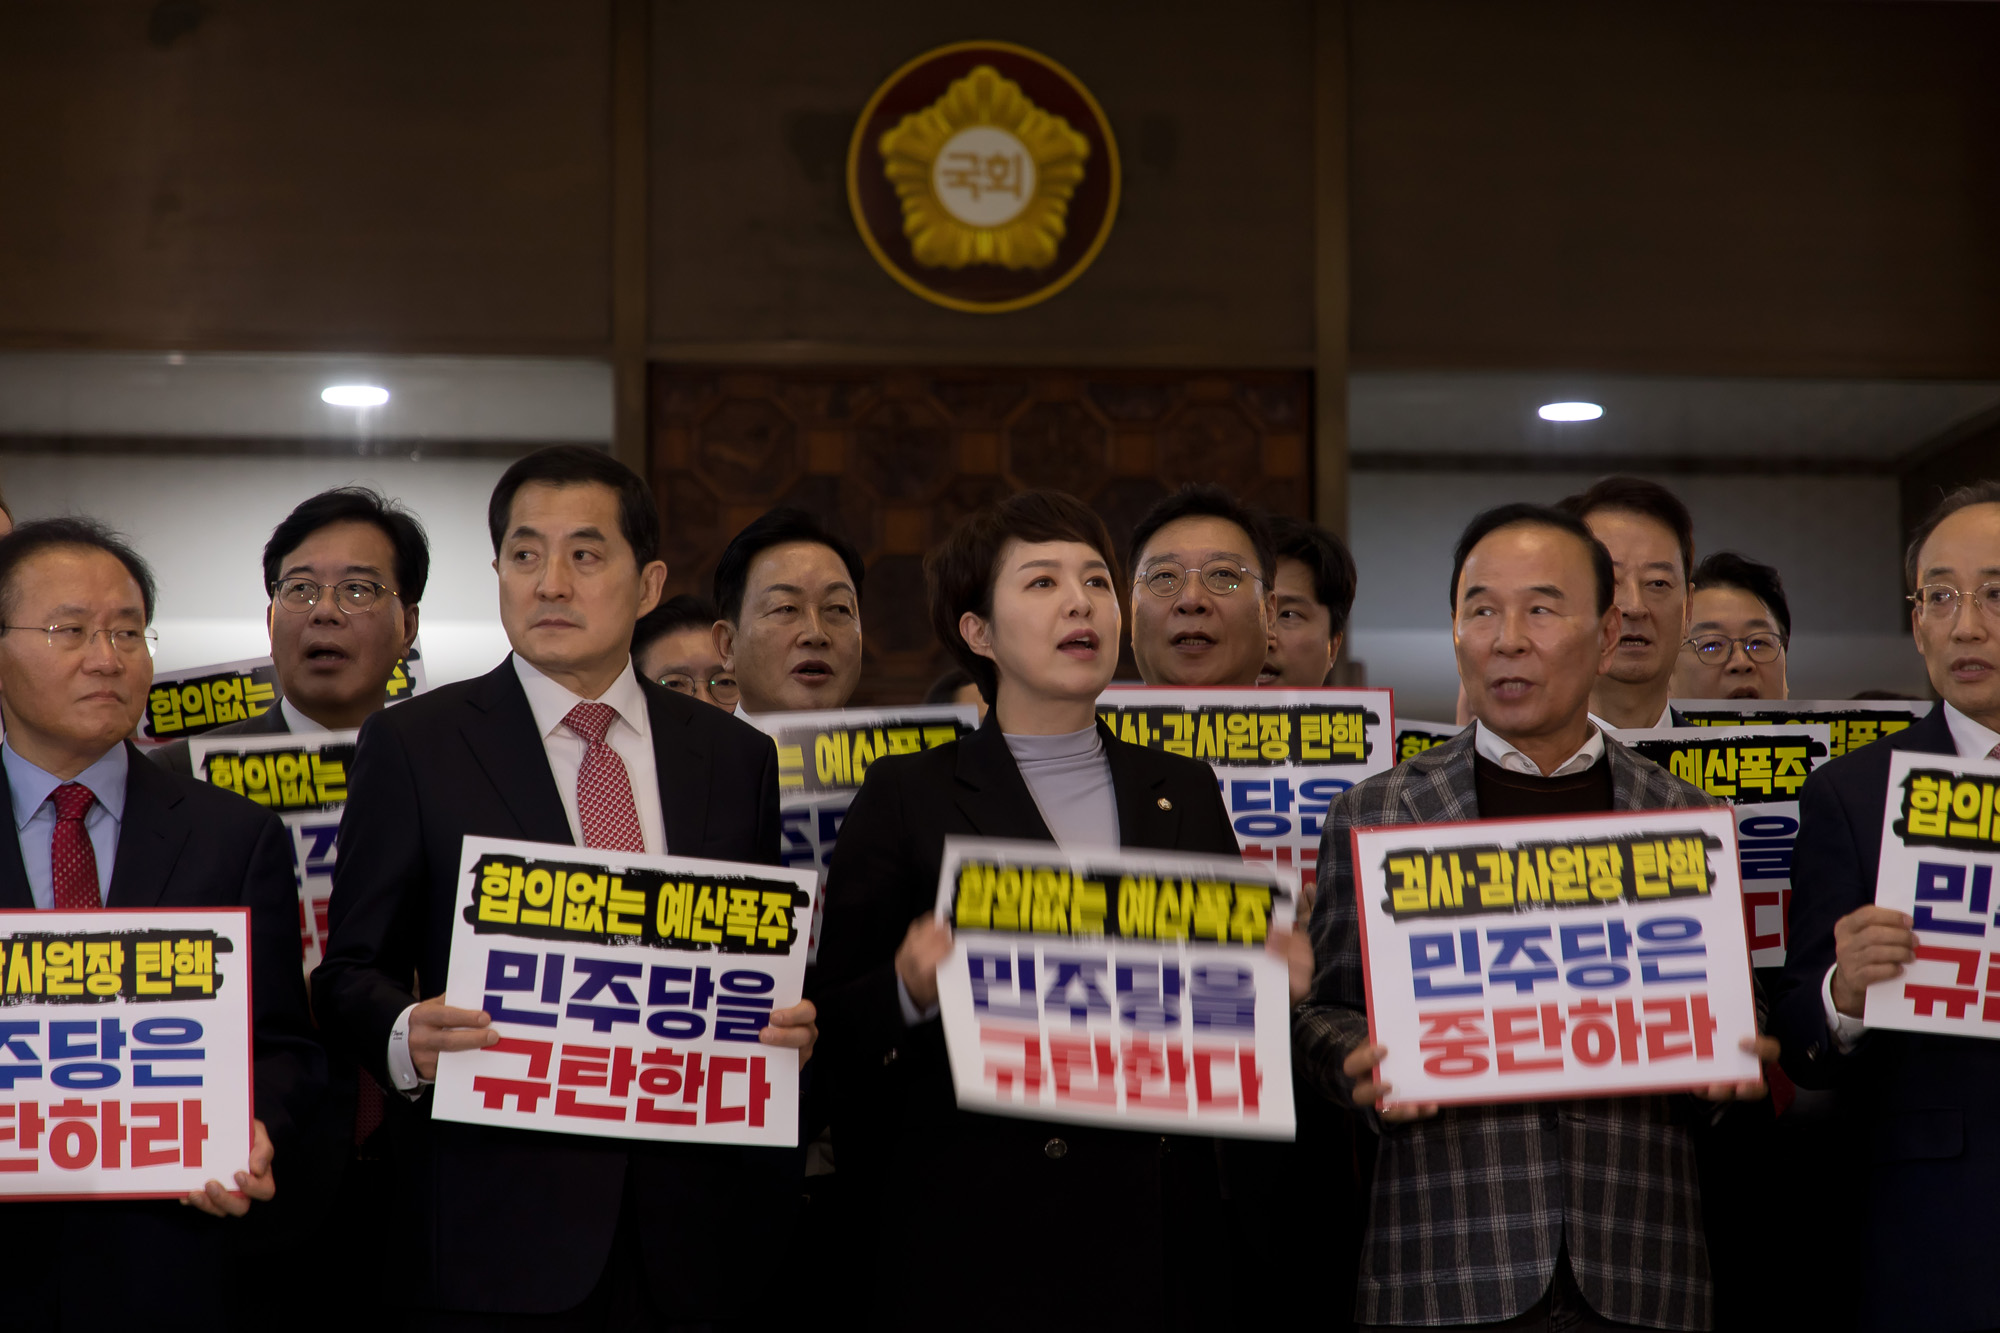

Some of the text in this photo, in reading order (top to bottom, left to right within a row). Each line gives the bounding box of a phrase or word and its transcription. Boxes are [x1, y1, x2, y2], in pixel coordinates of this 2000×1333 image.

[943, 152, 1024, 202] 국회
[150, 676, 275, 733] 합의없는
[1098, 712, 1292, 760] 사·감사원장
[1300, 712, 1365, 759] 탄핵
[1669, 746, 1808, 797] 예산폭주
[1907, 775, 2000, 843] 합의
[478, 862, 792, 948] 합의없는 예산폭주
[1389, 842, 1624, 912] 검사·감사원장
[1630, 836, 1709, 897] 탄핵
[136, 938, 214, 994] 탄핵
[1408, 916, 1708, 1001] 민주당은
[482, 949, 775, 1044] 민주당을
[1418, 993, 1718, 1080] 중단하라
[473, 1034, 771, 1128] 규탄한다
